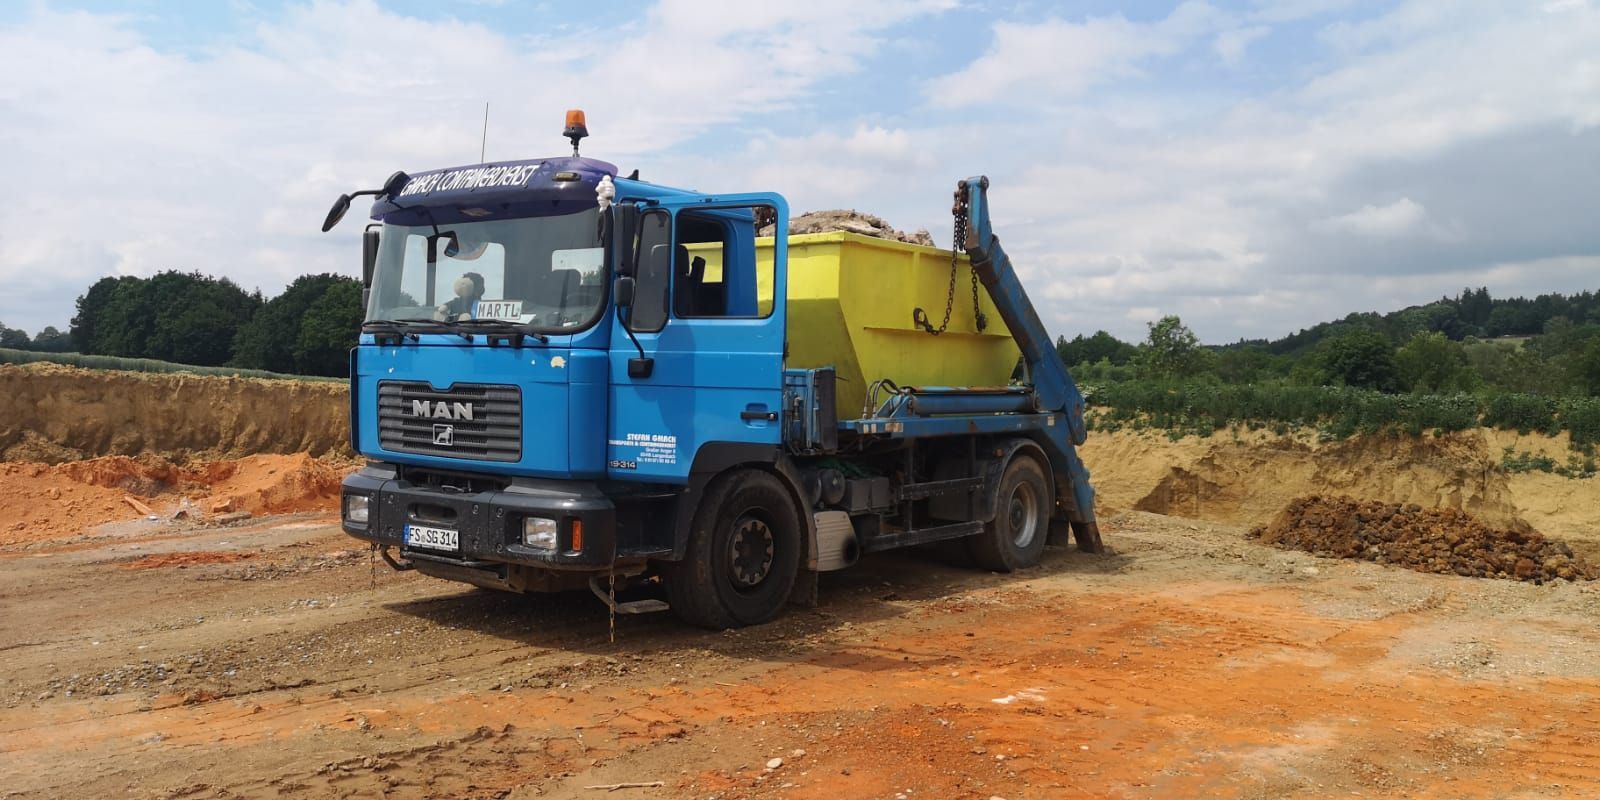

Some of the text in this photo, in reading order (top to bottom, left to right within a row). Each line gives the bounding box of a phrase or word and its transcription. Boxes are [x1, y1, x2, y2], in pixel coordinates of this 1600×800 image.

[400, 165, 540, 197] GMACH CONTAINERDIENST
[412, 400, 473, 420] MAN
[627, 433, 677, 443] STEFAN GMACH
[409, 527, 457, 547] FS SG 314
